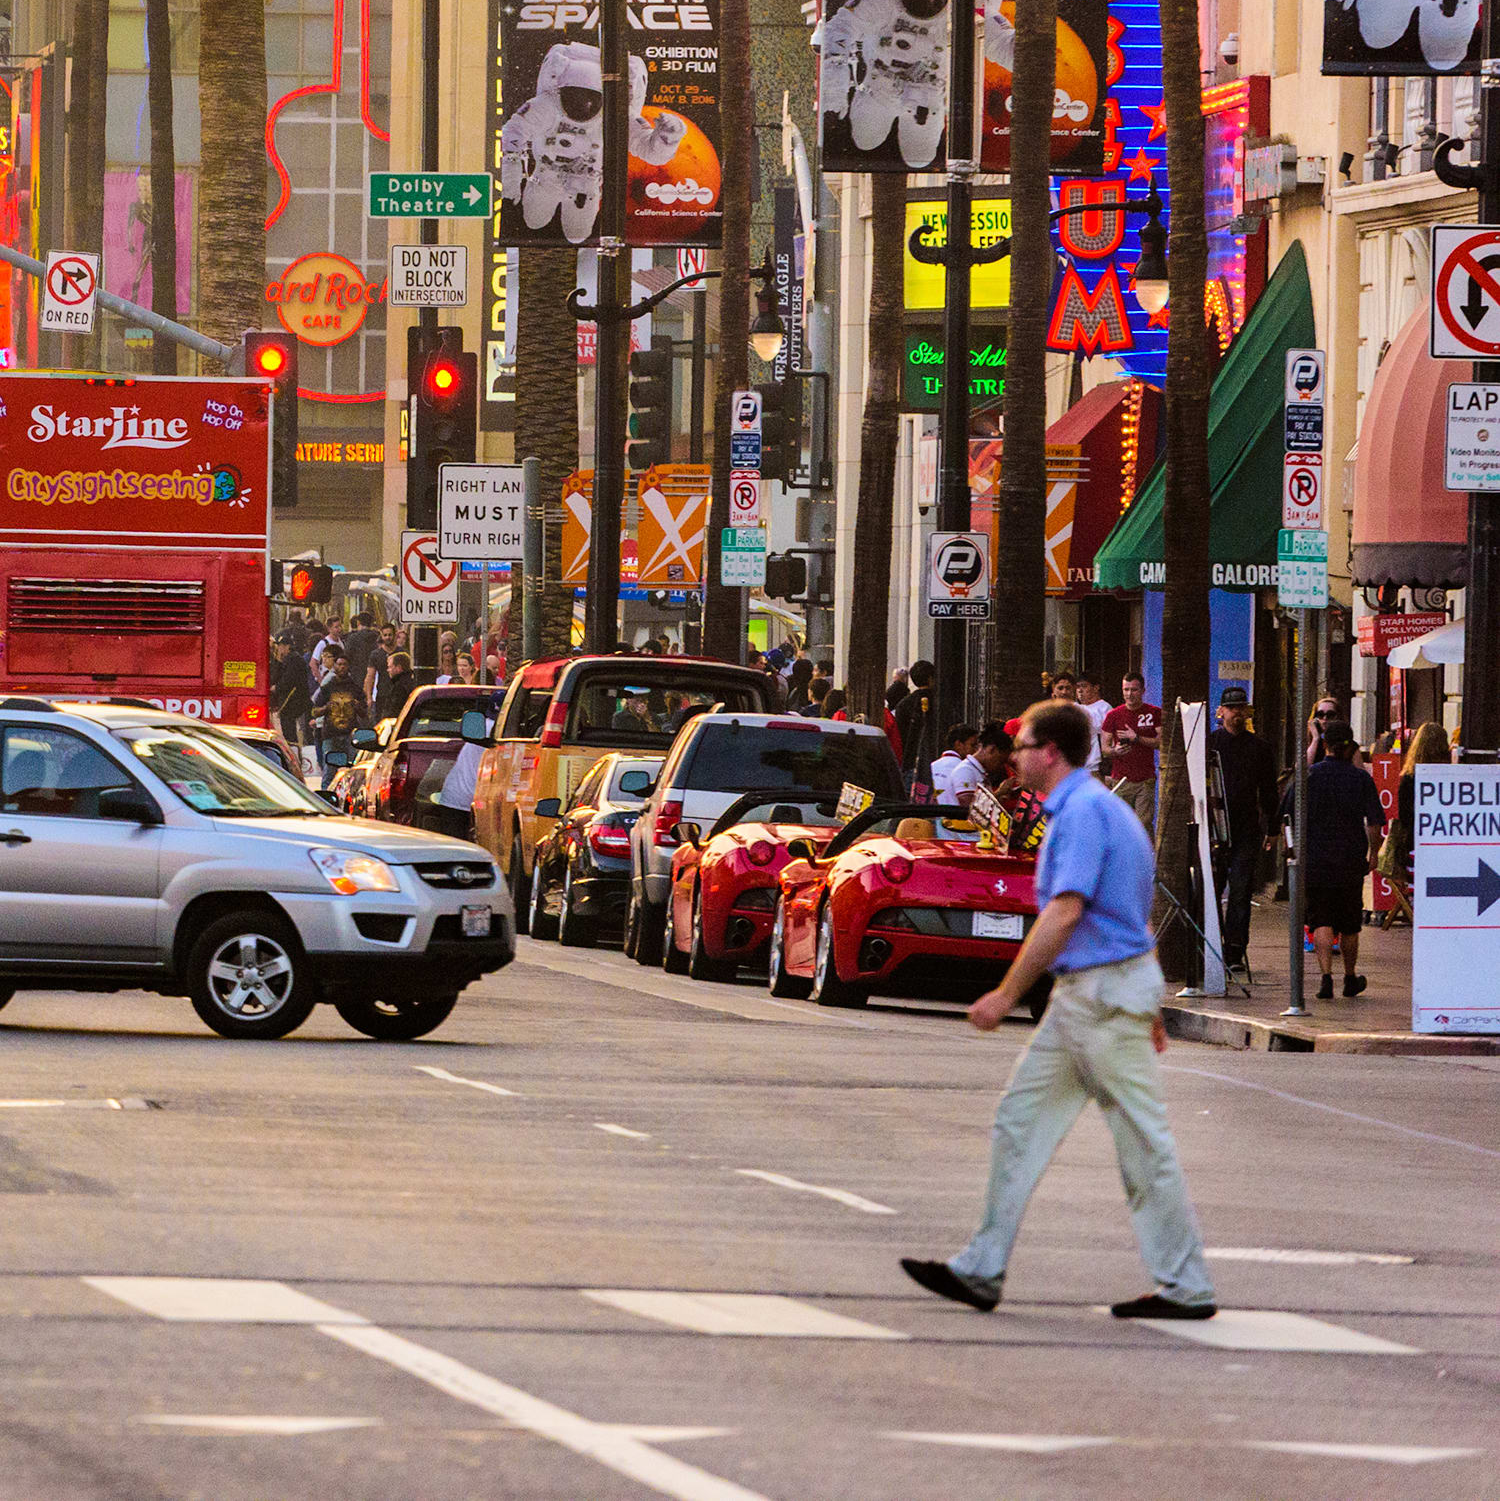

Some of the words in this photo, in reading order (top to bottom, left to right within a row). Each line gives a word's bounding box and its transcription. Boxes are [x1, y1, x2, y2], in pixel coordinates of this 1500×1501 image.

[645, 46, 718, 59] EXHIBITION
[387, 178, 445, 197] Dolby
[377, 197, 456, 213] Theatre
[401, 250, 422, 268] DO
[428, 250, 458, 268] NOT
[404, 270, 452, 288] BLOCK
[776, 253, 790, 307] EAGLE
[265, 272, 321, 305] ard
[393, 289, 464, 303] INTERSECTION
[46, 310, 62, 322] ON
[66, 311, 89, 325] RED
[790, 284, 803, 371] OUTFITTERS
[206, 399, 228, 415] Hop
[229, 405, 244, 418] On
[1452, 391, 1499, 411] LAP
[27, 404, 192, 451] StarLine
[201, 412, 224, 429] Hop
[224, 416, 244, 431] Off
[1450, 448, 1472, 457] Video
[1451, 472, 1465, 481] For
[7, 468, 215, 506] CitySightseeing
[445, 480, 487, 493] RIGHT
[454, 505, 519, 521] MUST
[444, 531, 481, 545] TURN
[1211, 562, 1279, 586] GALORE
[405, 599, 424, 614] ON
[428, 599, 454, 615] RED
[931, 604, 952, 615] PAY
[956, 604, 985, 615] HERE
[1380, 617, 1406, 626] STAR
[1407, 617, 1444, 626] HOMES
[1137, 713, 1154, 727] 22
[1419, 781, 1500, 806] PUBLI
[1418, 812, 1500, 836] PARKIN
